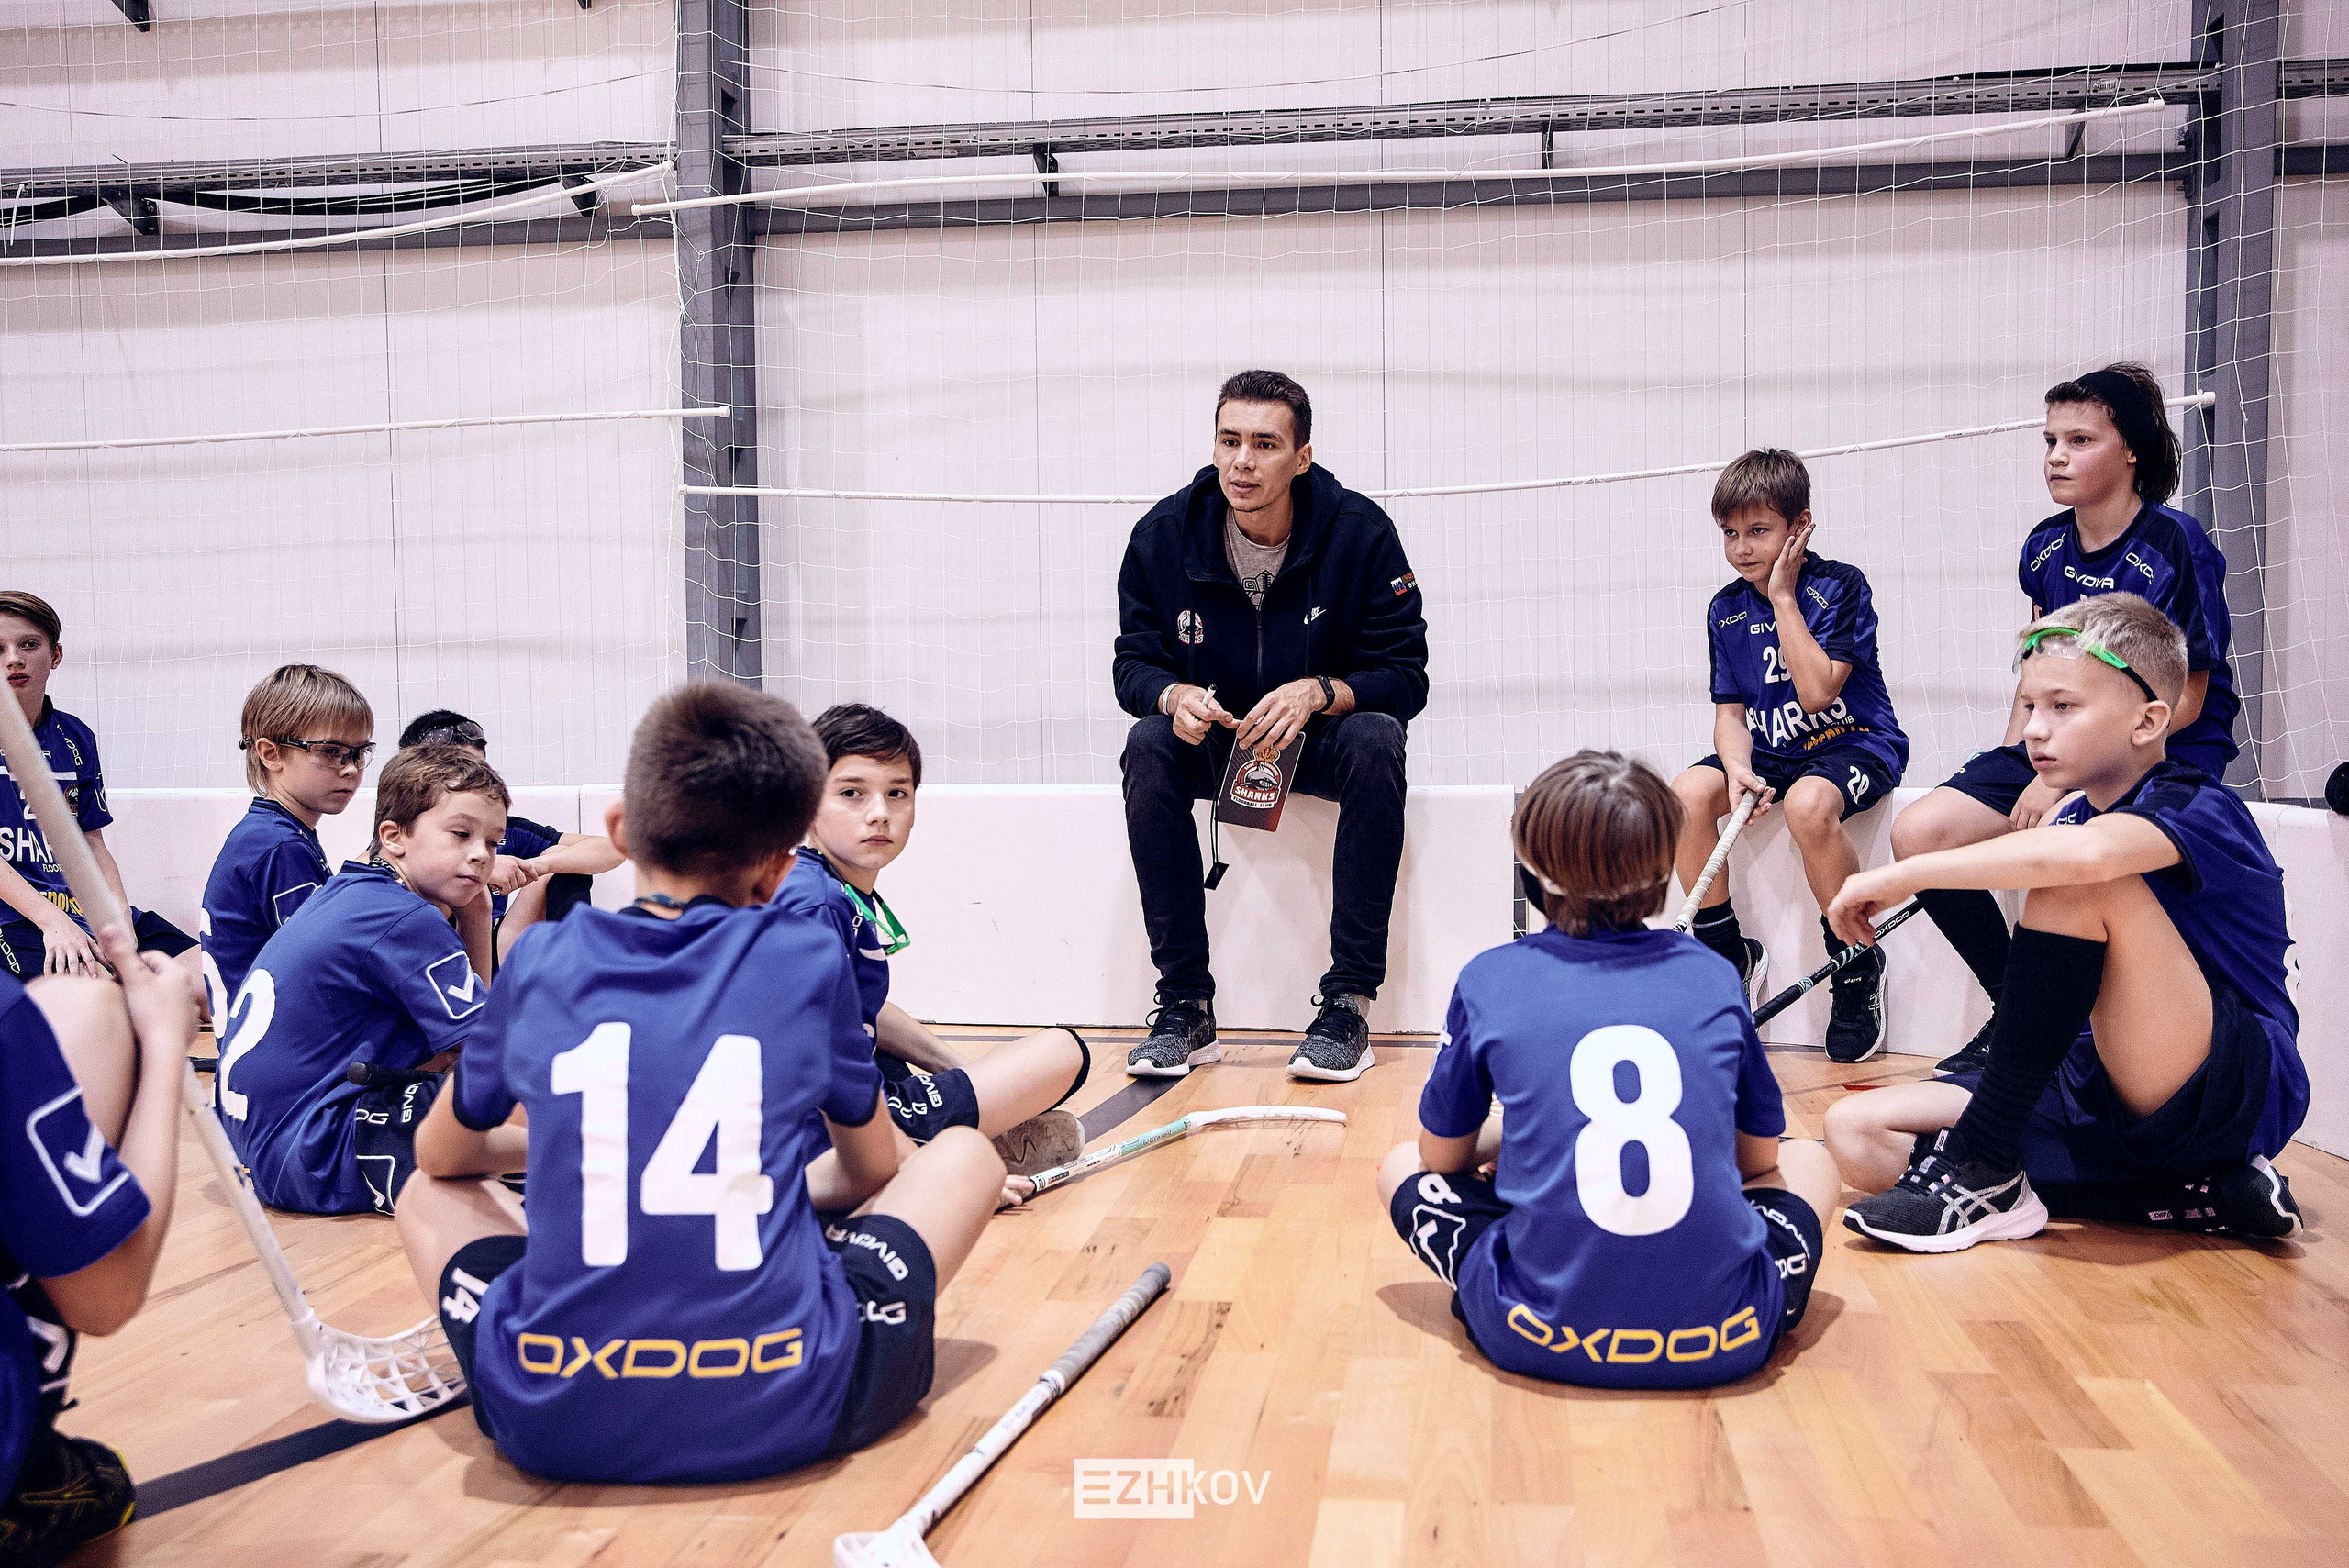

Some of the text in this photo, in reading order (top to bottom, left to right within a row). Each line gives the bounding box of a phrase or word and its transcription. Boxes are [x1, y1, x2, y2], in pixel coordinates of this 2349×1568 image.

[2125, 551, 2154, 585] OXD
[1719, 610, 1748, 629] XDO
[1750, 621, 1776, 635] GIV
[1234, 785, 1275, 801] SHARKS
[214, 968, 276, 1121] 2
[551, 1021, 773, 1272] 14
[1569, 1024, 1694, 1236] 8
[442, 1266, 490, 1324] 14
[517, 1327, 803, 1380] OXDOG
[1507, 1304, 1761, 1363] OXDOG
